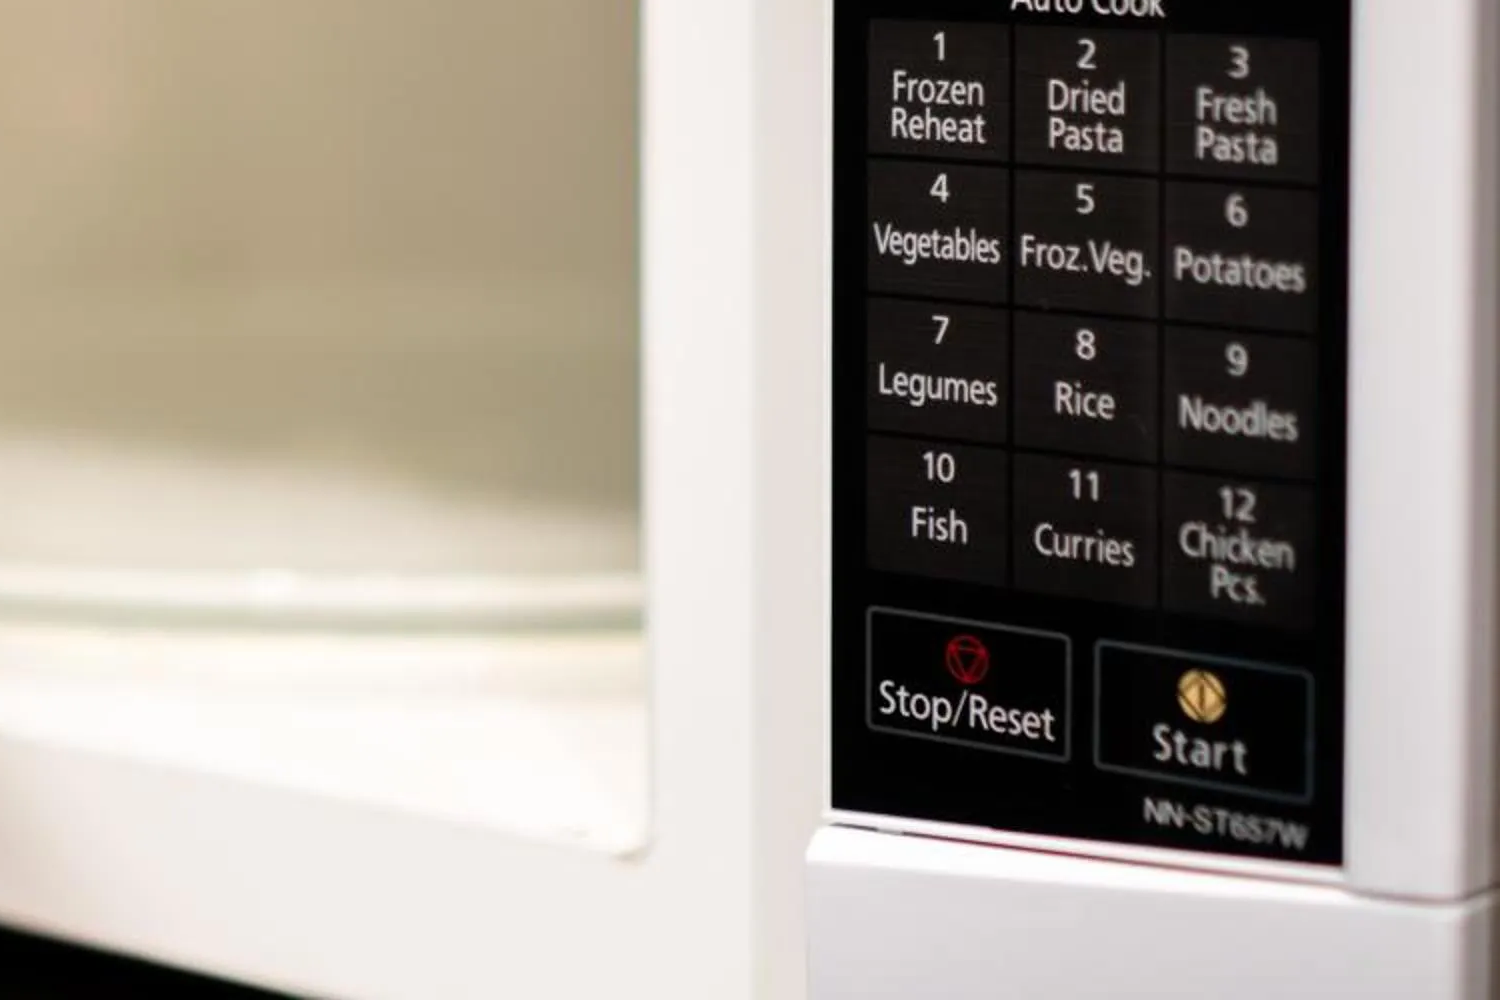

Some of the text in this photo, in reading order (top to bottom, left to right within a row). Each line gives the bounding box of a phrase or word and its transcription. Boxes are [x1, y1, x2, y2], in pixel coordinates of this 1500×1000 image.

[933, 31, 945, 61] 1
[1077, 38, 1097, 69] 2
[1229, 46, 1249, 79] 3
[893, 69, 984, 109] Frozen
[1048, 78, 1125, 115] Dried
[1197, 86, 1277, 124] Fresh
[891, 107, 986, 144] Reheat
[1049, 116, 1124, 153] Pasta
[1196, 125, 1278, 165] Pasta
[929, 173, 950, 203] 4
[1076, 183, 1095, 214] 5
[1225, 194, 1248, 227] 6
[873, 222, 1001, 265] Vegetables
[1174, 246, 1305, 292] Potatoes
[932, 315, 950, 345] 7
[1076, 329, 1096, 361] 8
[1226, 343, 1248, 376] 9
[879, 362, 998, 407] Legumes
[1055, 380, 1115, 420] Rice
[1179, 394, 1298, 441] Noodles
[923, 451, 955, 483] 10
[1069, 469, 1099, 501] 11
[1220, 487, 1256, 522] 12
[911, 505, 968, 544] Fish
[1034, 522, 1135, 567] Curries
[1179, 519, 1294, 570] Chicken
[1210, 566, 1267, 604] Pcs.
[879, 679, 1055, 742] Stop/Reset
[1153, 724, 1246, 774] Start
